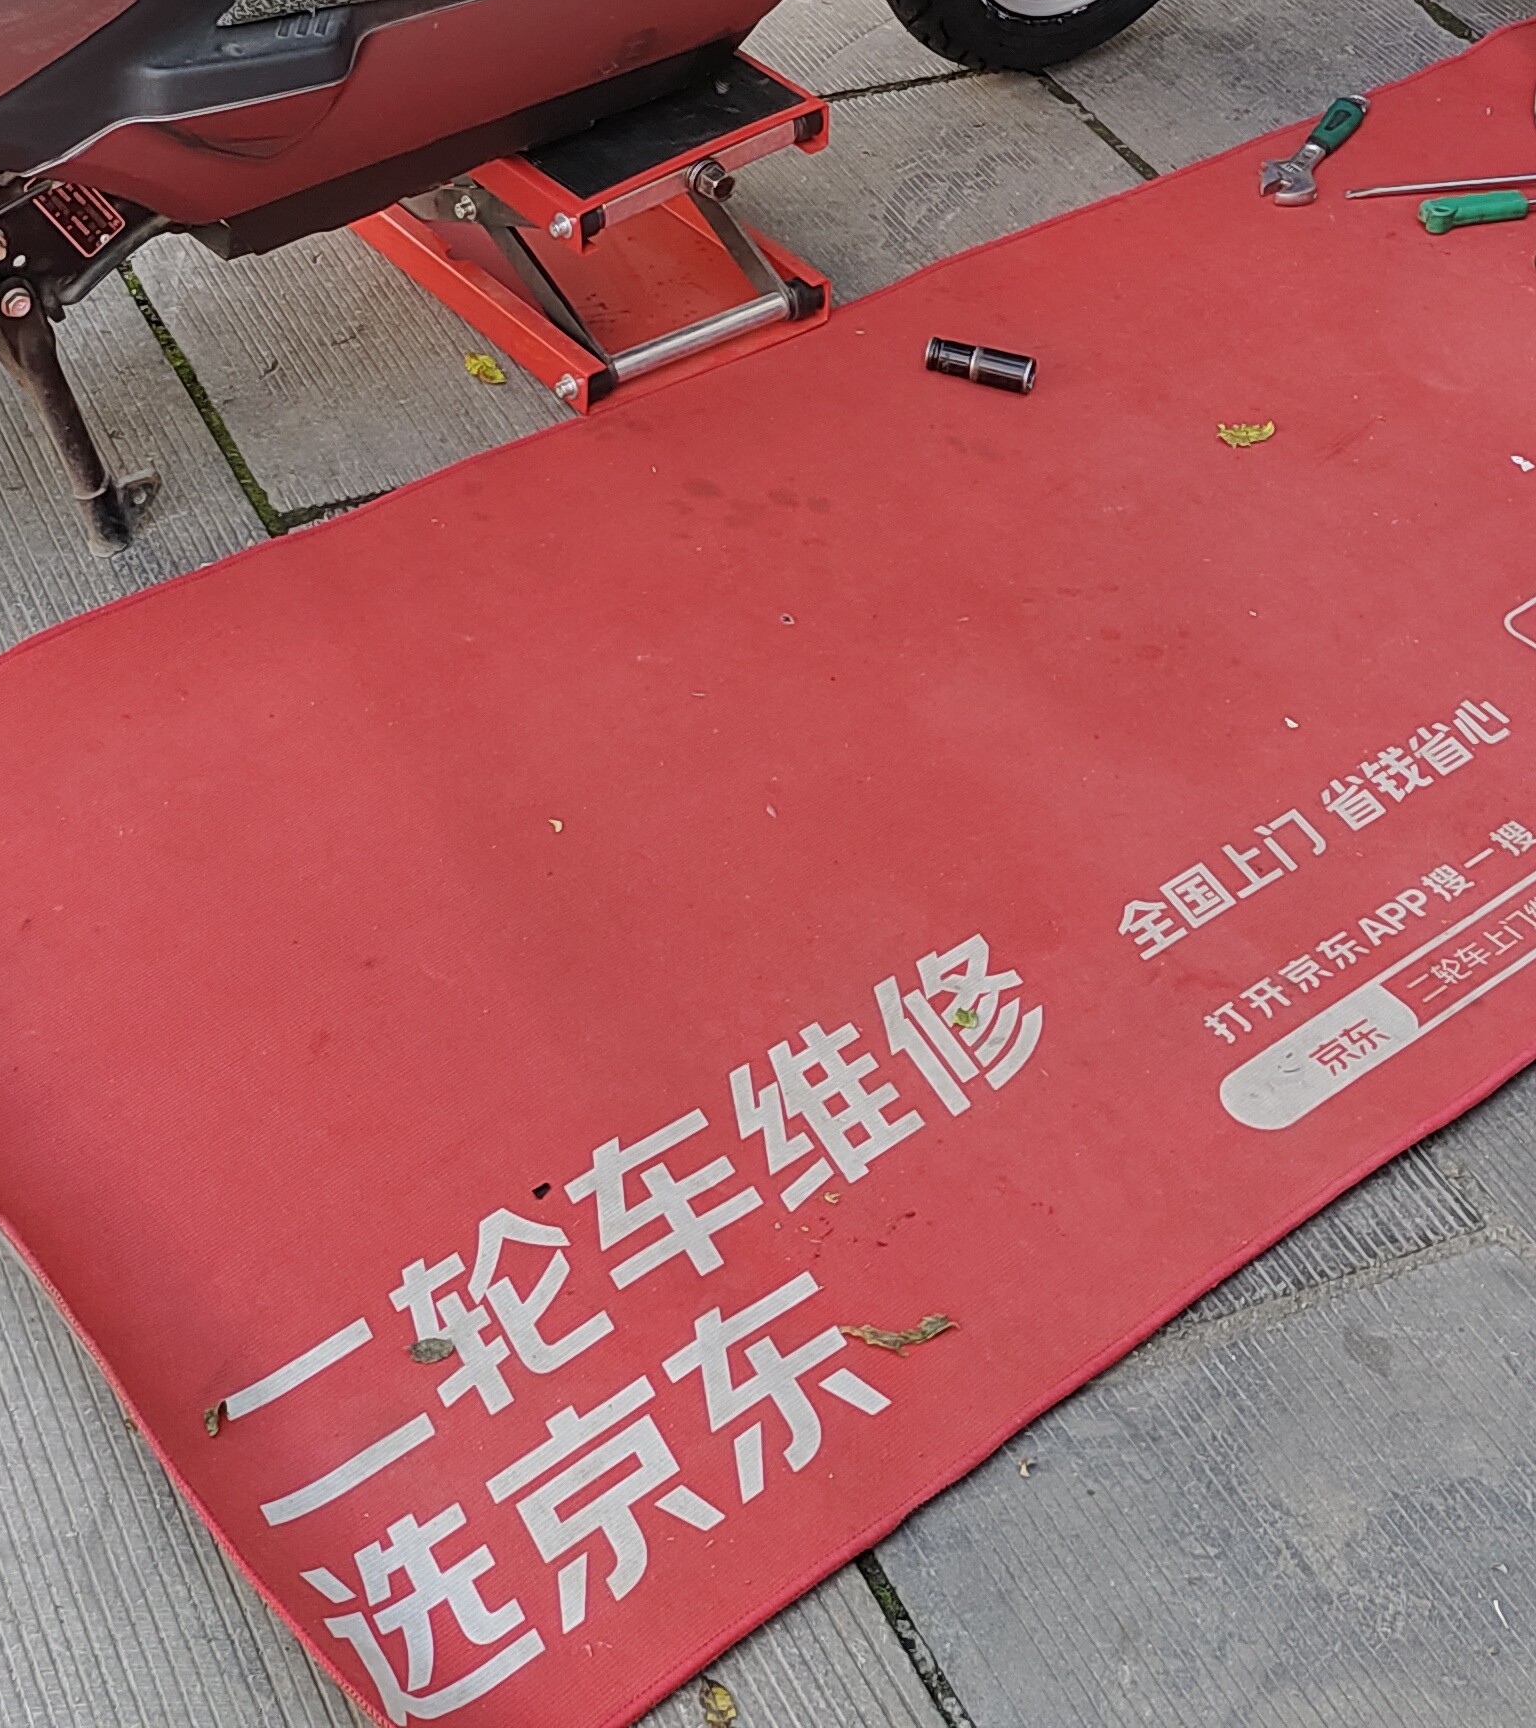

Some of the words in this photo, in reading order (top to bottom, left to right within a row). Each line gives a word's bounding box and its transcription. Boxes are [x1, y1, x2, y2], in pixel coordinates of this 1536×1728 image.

[1118, 809, 1327, 960] 全国上门
[1321, 699, 1511, 831] 省钱省心
[1308, 1018, 1391, 1076] 京东
[223, 933, 1044, 1527] 二轮车维修
[300, 1271, 893, 1726] 选京东
